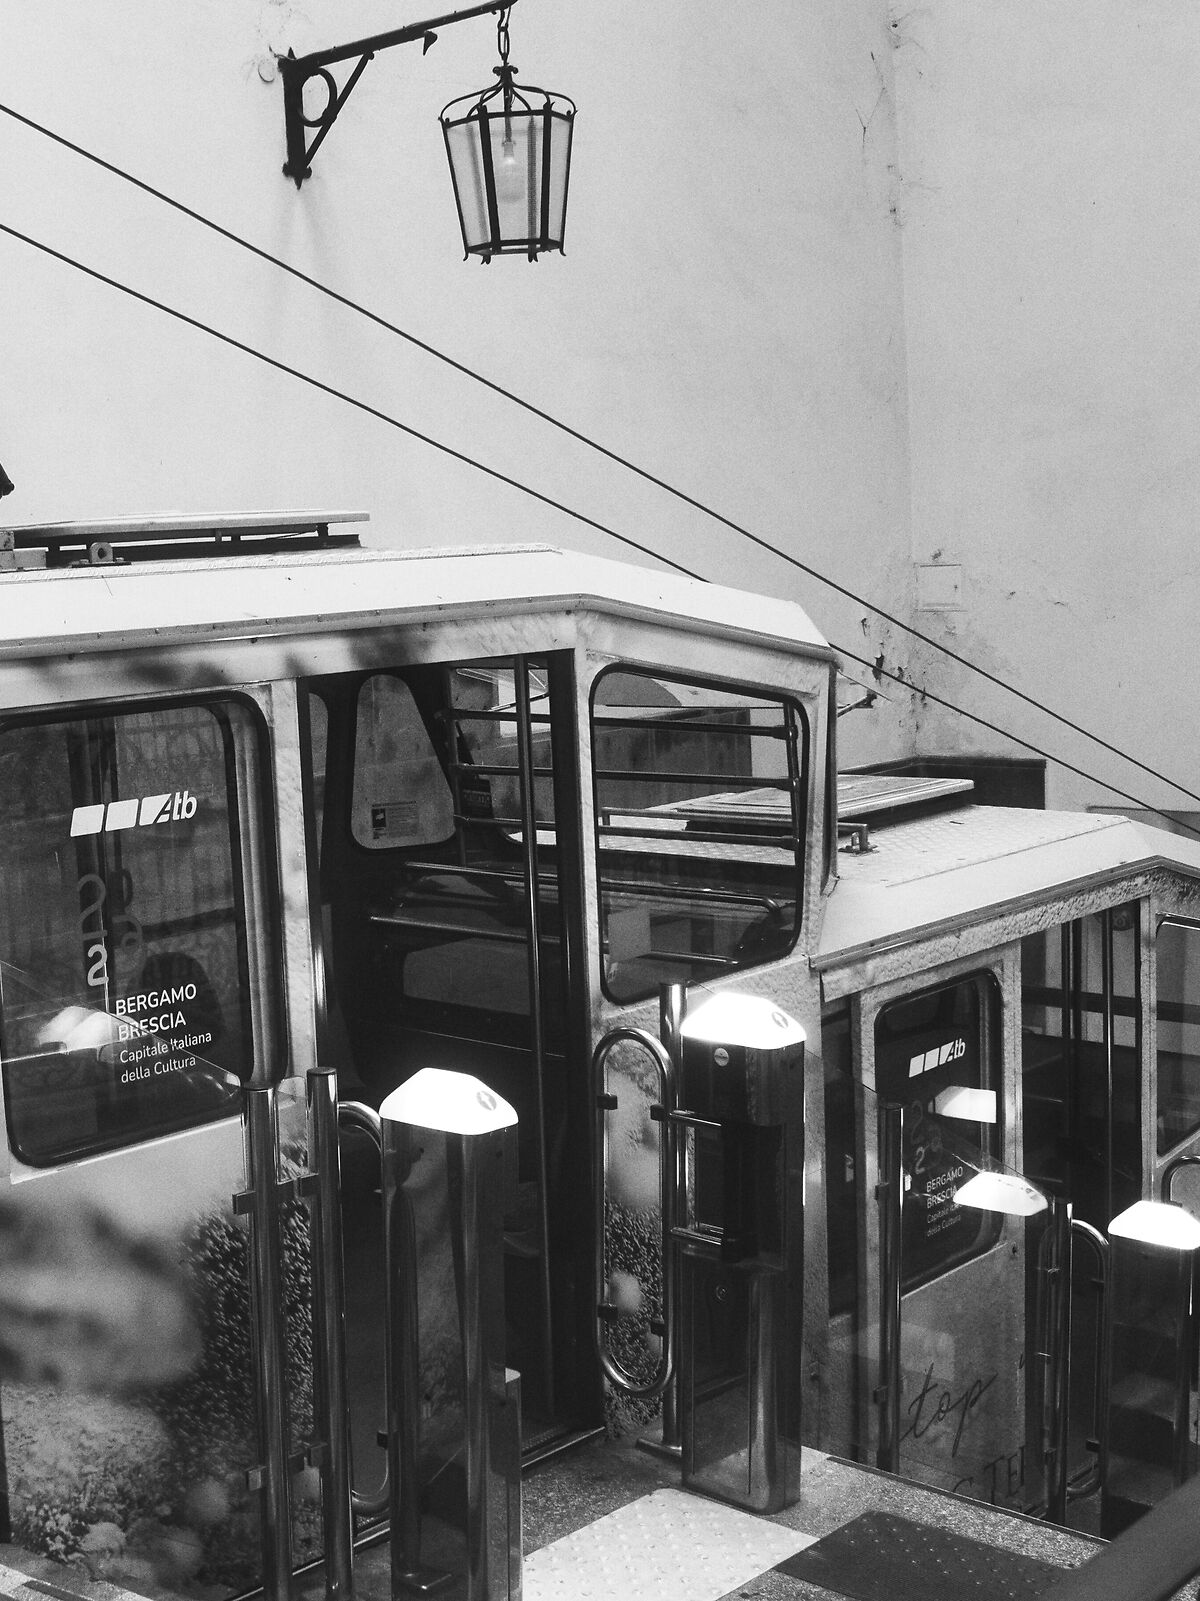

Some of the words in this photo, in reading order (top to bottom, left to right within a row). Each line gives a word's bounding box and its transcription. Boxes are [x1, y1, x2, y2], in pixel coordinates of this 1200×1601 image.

[115, 983, 198, 1016] BERGAMO
[118, 1010, 187, 1042] BRESCIA
[120, 1042, 169, 1063] Capitale
[170, 1032, 212, 1052] Italiana
[121, 1066, 151, 1084] della
[154, 1056, 197, 1075] Cultura
[926, 1166, 964, 1193] BERGAMO
